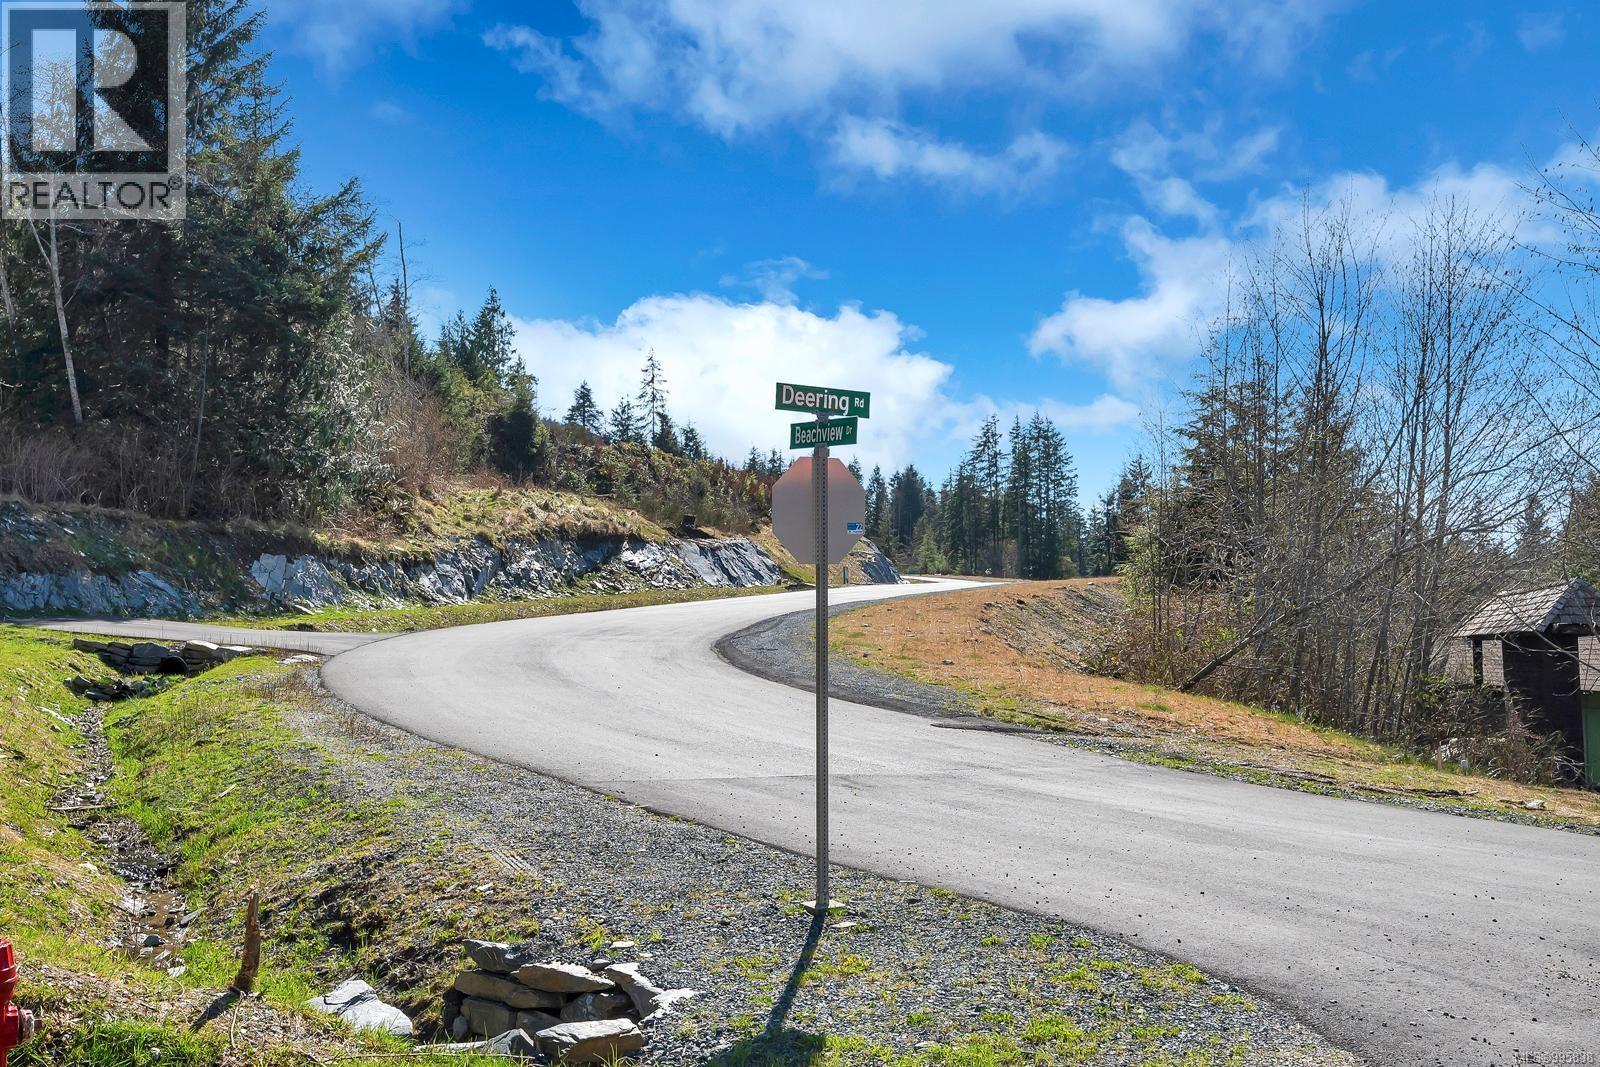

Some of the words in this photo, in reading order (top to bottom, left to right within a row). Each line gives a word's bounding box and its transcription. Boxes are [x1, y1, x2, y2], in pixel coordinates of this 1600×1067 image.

[782, 384, 849, 415] Deering
[854, 397, 864, 408] Rd
[795, 422, 843, 443] Beachview
[846, 425, 852, 435] Dr
